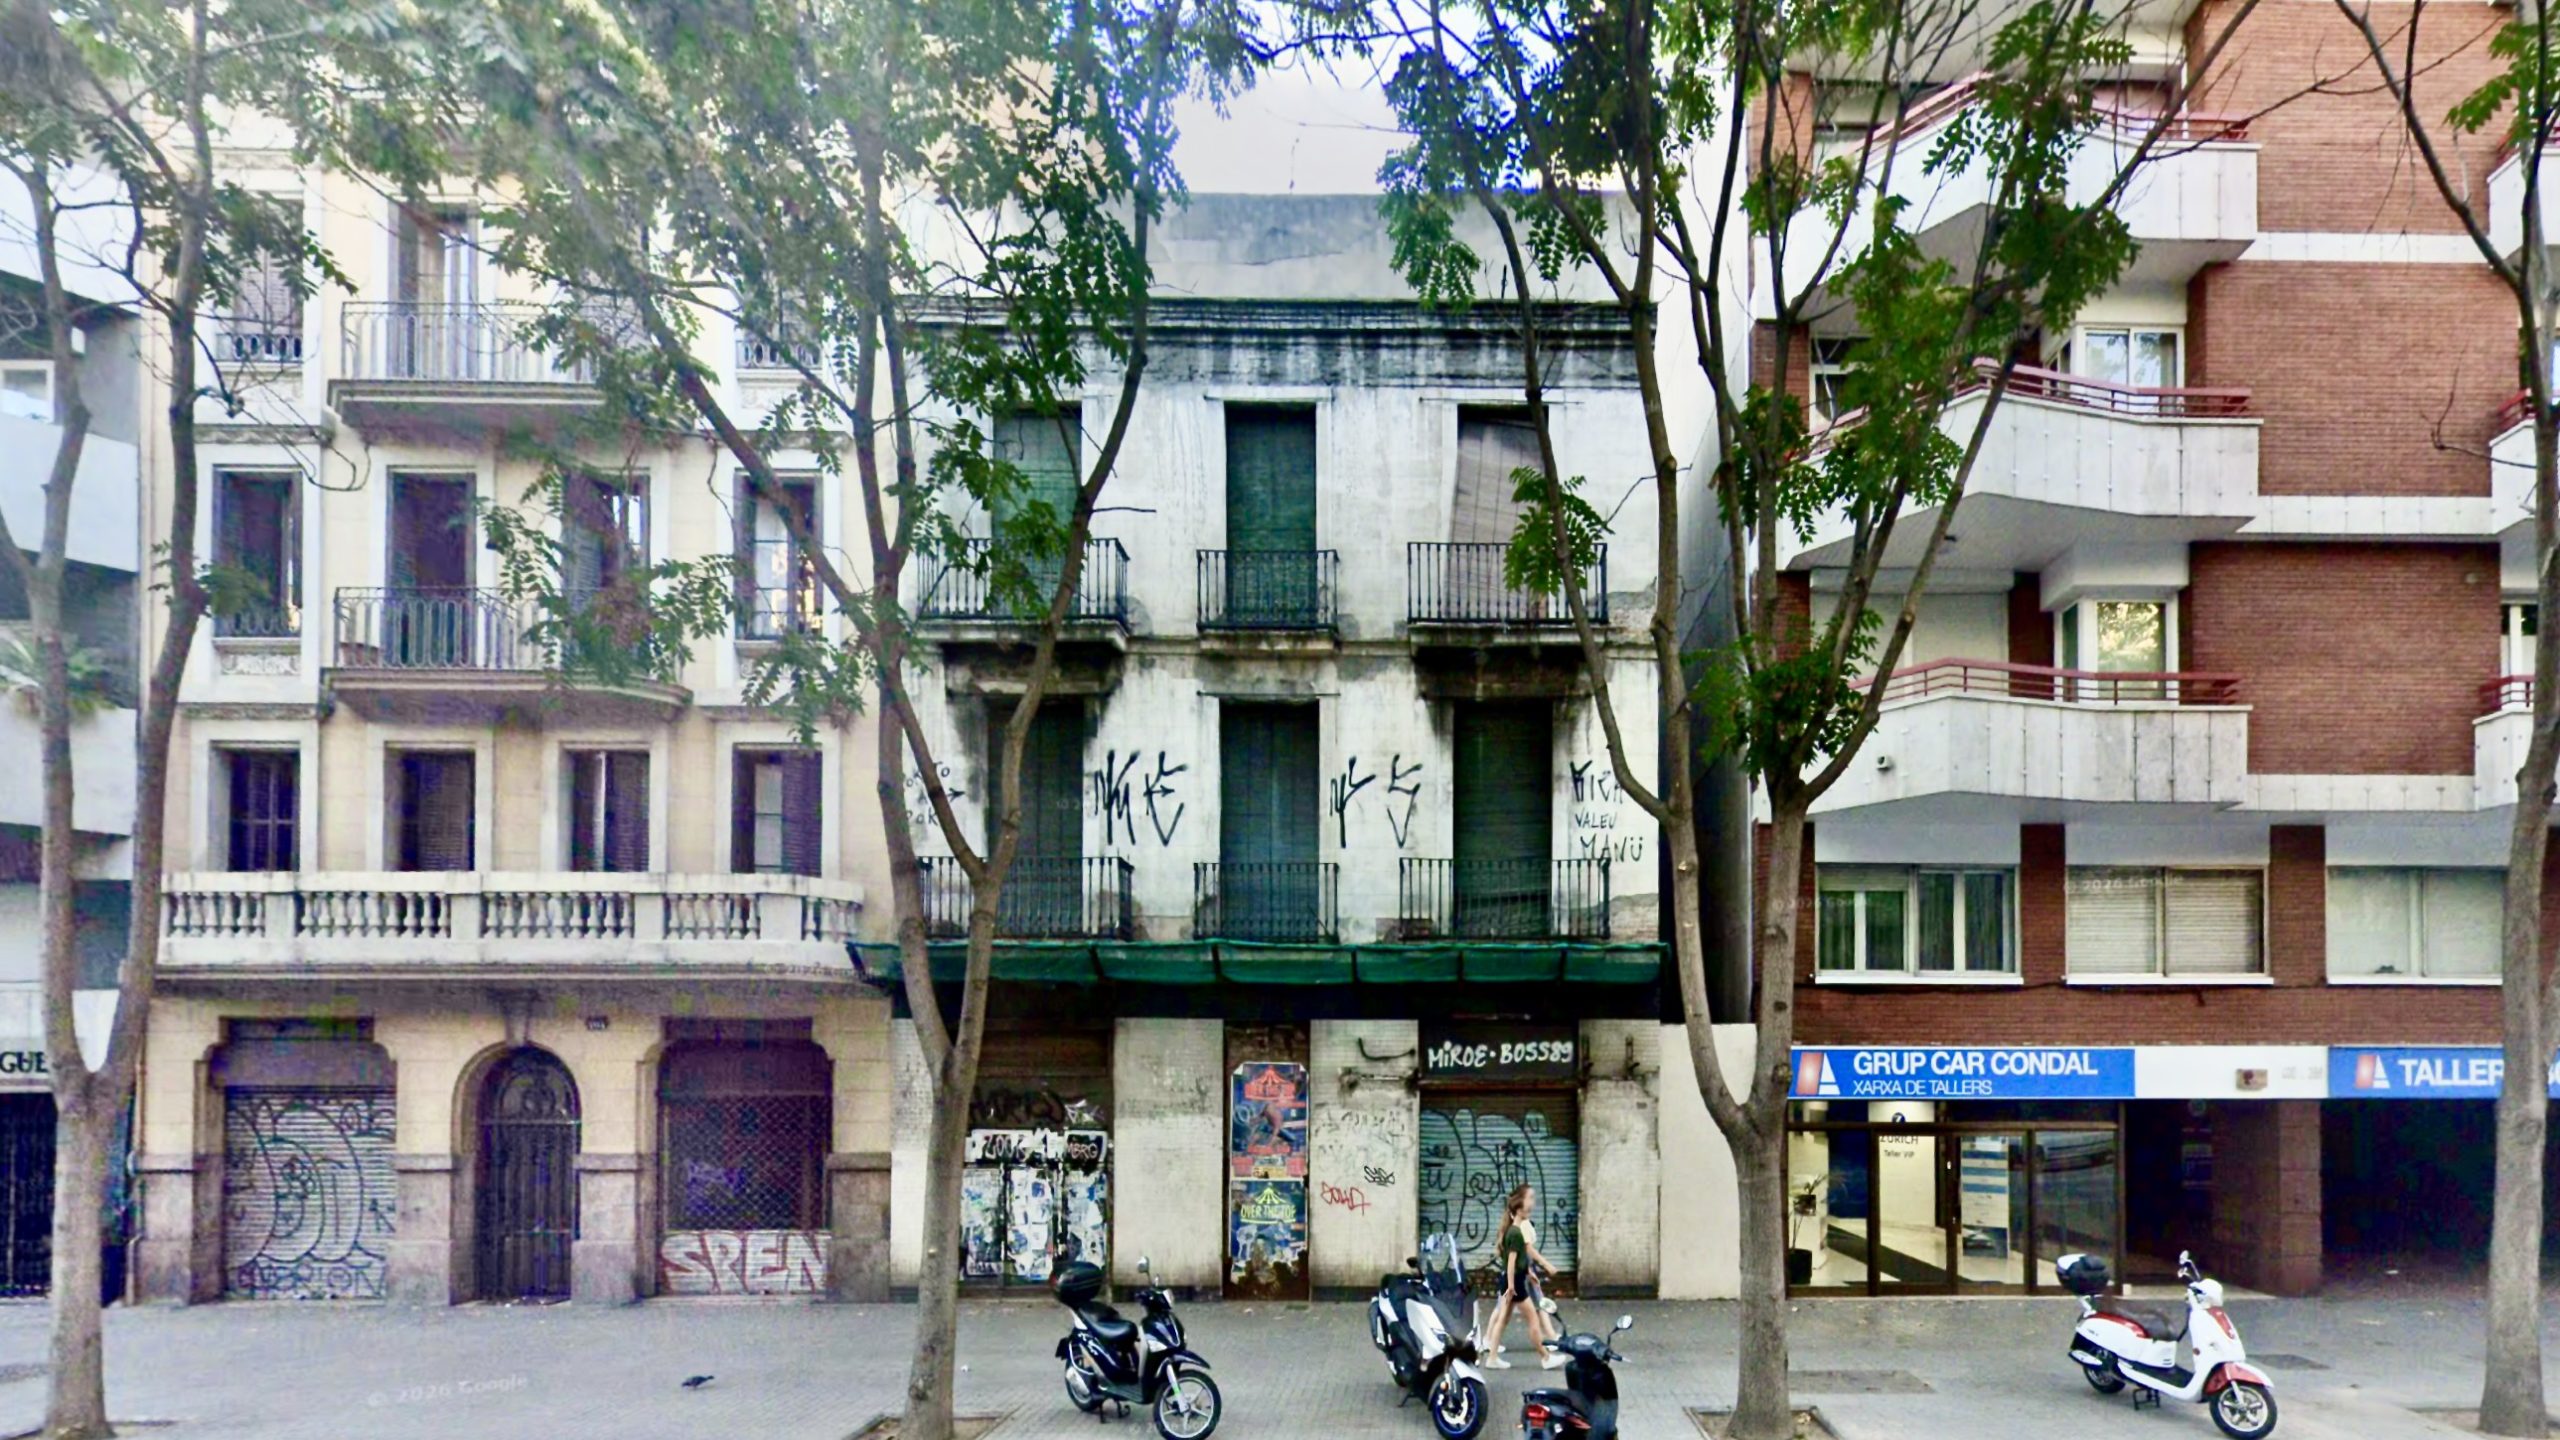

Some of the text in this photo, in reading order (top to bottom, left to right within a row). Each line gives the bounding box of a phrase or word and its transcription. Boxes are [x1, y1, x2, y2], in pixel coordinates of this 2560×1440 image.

[1853, 1052, 2098, 1075] GRUP CAR CONDAL
[1853, 1080, 1992, 1095] XARXA DE TALLERS
